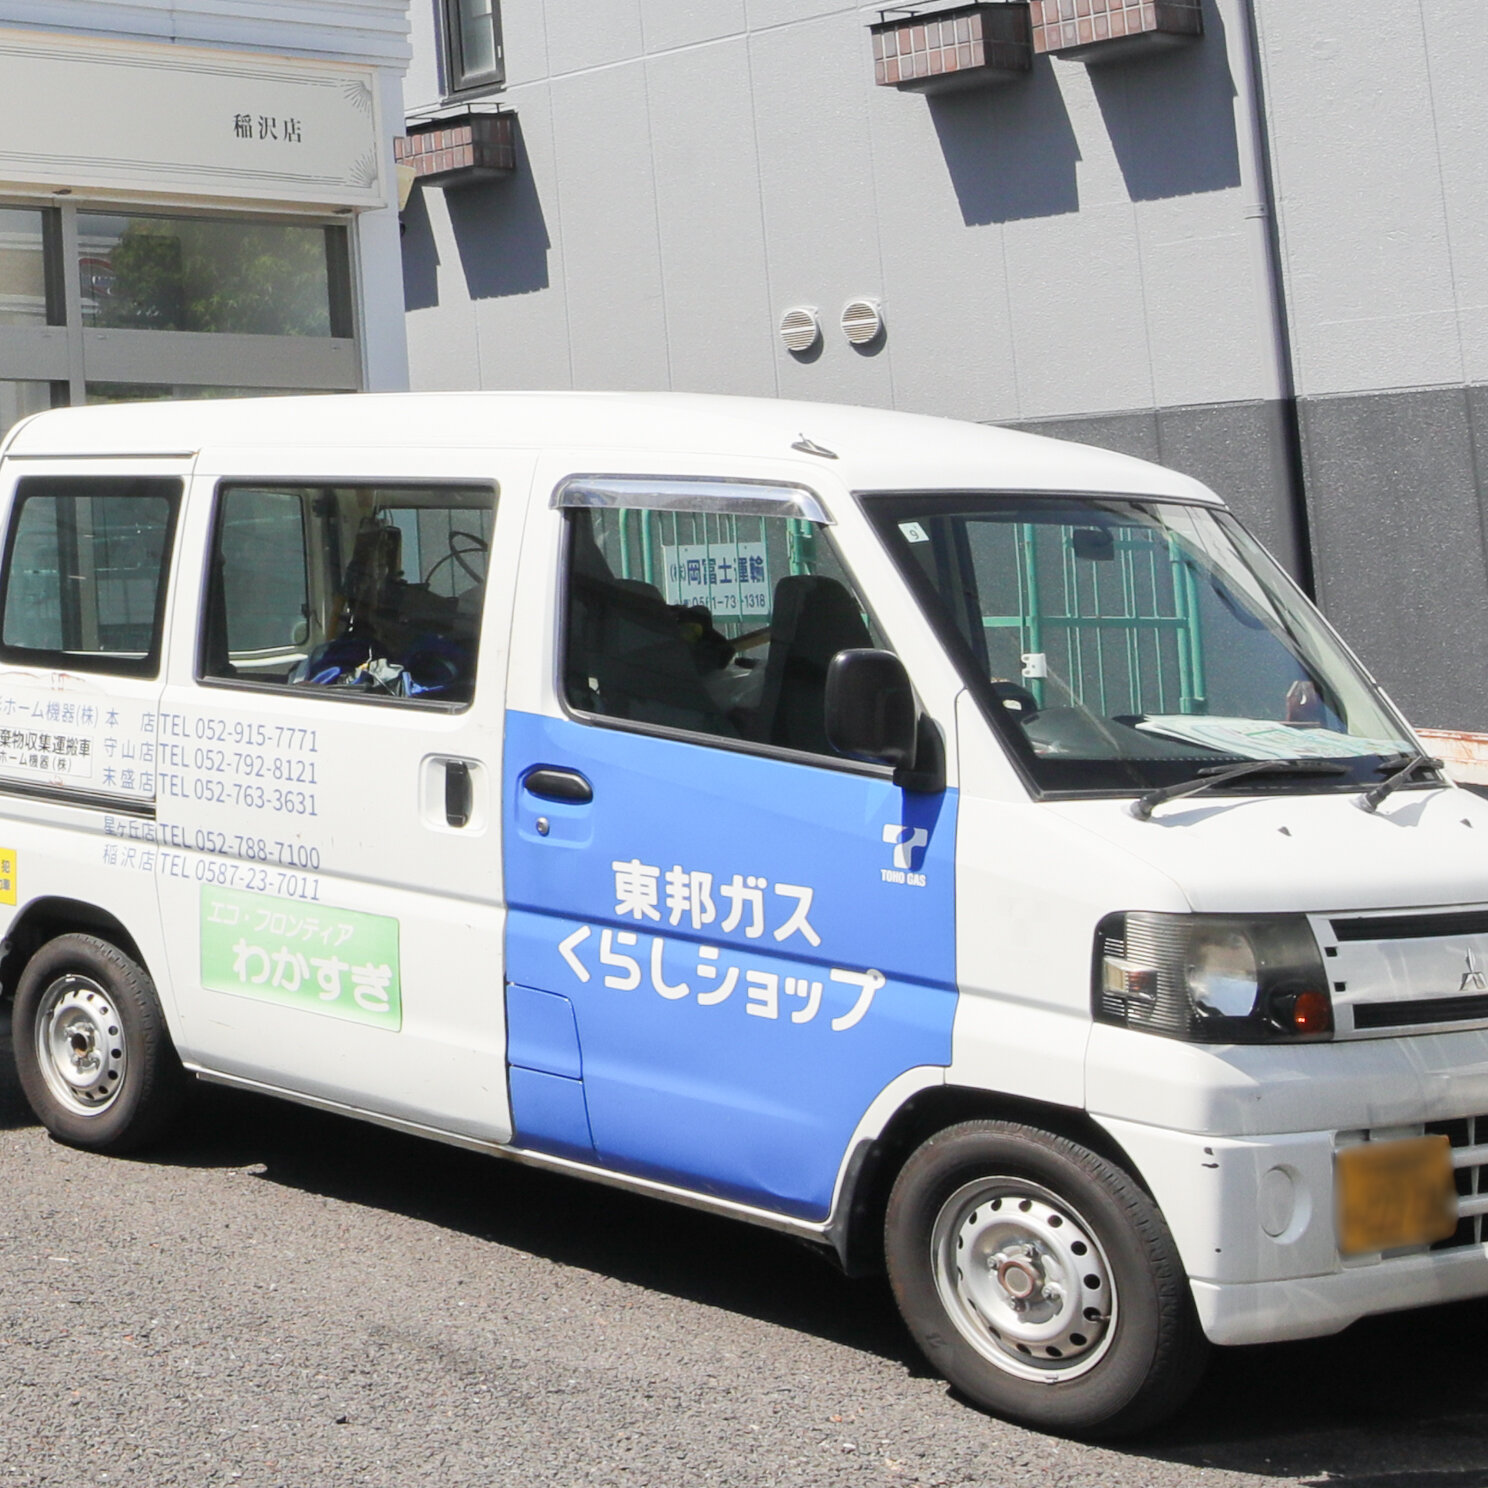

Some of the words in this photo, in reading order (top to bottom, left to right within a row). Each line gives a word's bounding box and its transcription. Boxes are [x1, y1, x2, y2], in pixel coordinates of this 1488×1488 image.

[232, 113, 303, 144] 稲沢店
[160, 713, 190, 738] TEL
[195, 718, 318, 753] 052-915-7771
[103, 736, 155, 763] 守山店
[159, 743, 190, 768] TEL
[194, 748, 317, 784] 052-792-8121
[159, 773, 190, 798] TEL
[194, 778, 318, 816] 052-763-3631
[159, 823, 192, 849] TEL
[195, 829, 321, 870] 052-788-7100
[103, 843, 156, 872] 稲沢店
[160, 852, 190, 879] TEL
[195, 859, 320, 901] 0587-23-7011
[880, 869, 905, 884] TOHO
[906, 872, 927, 887] GAS
[207, 901, 355, 946] エコ・フロンティア
[611, 858, 824, 949] 東邦ガス
[232, 938, 393, 1012] わかすぎ
[557, 925, 887, 1032] くらしショップ
